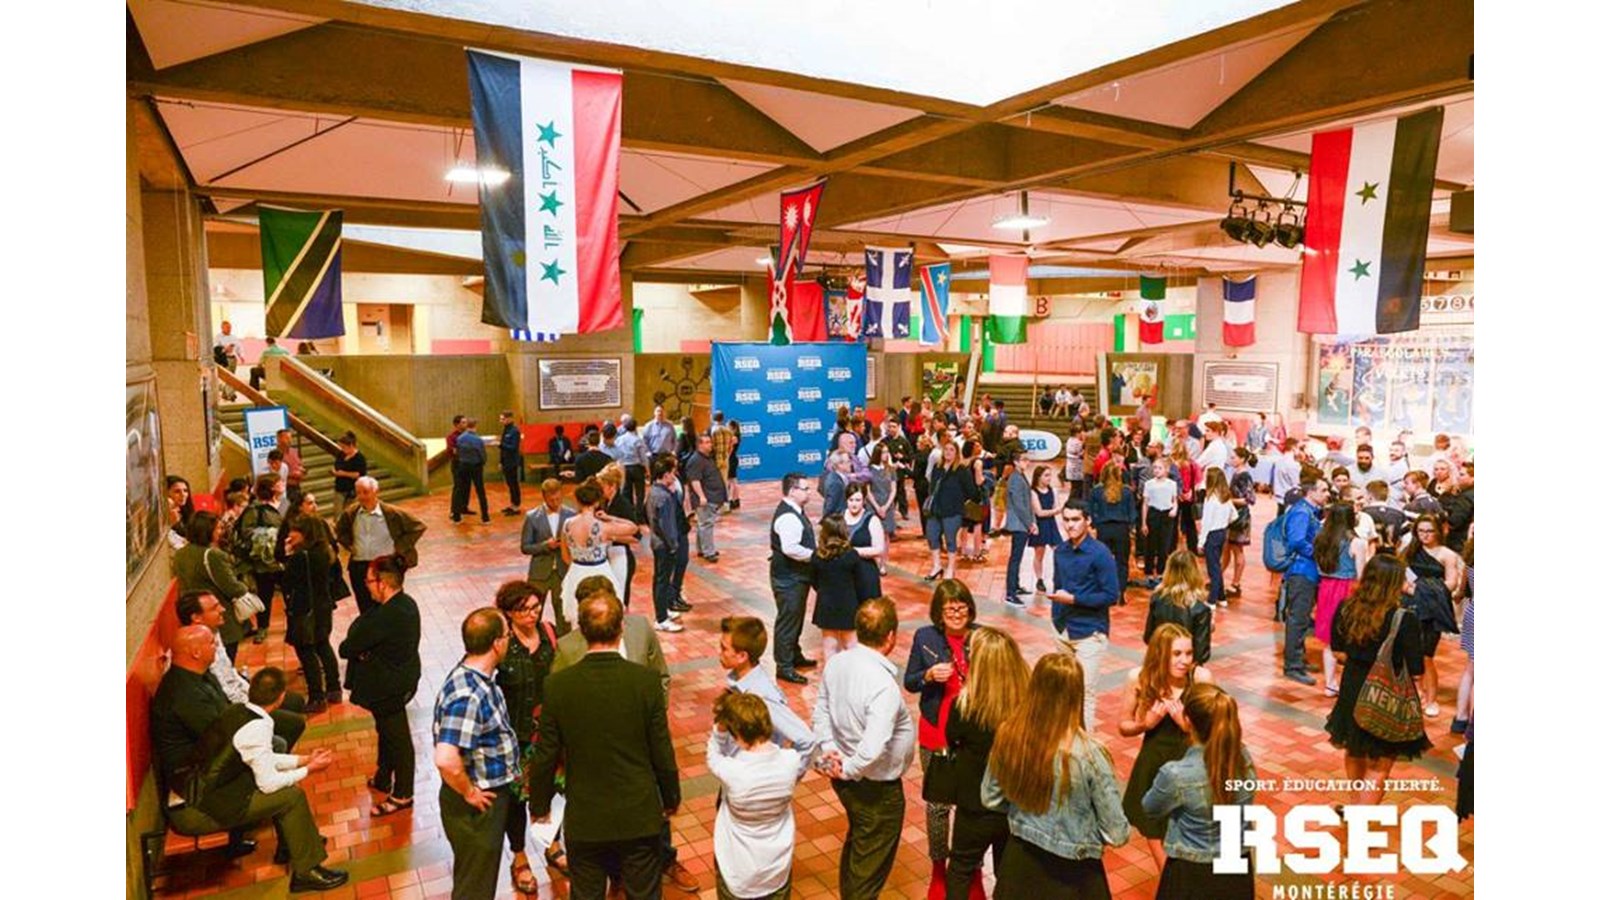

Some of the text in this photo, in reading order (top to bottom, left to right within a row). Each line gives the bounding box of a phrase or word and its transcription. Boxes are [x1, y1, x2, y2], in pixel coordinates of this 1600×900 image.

[1036, 296, 1048, 314] B
[253, 435, 277, 449] RSE
[1020, 438, 1048, 450] SEQ
[1366, 685, 1400, 715] NEW
